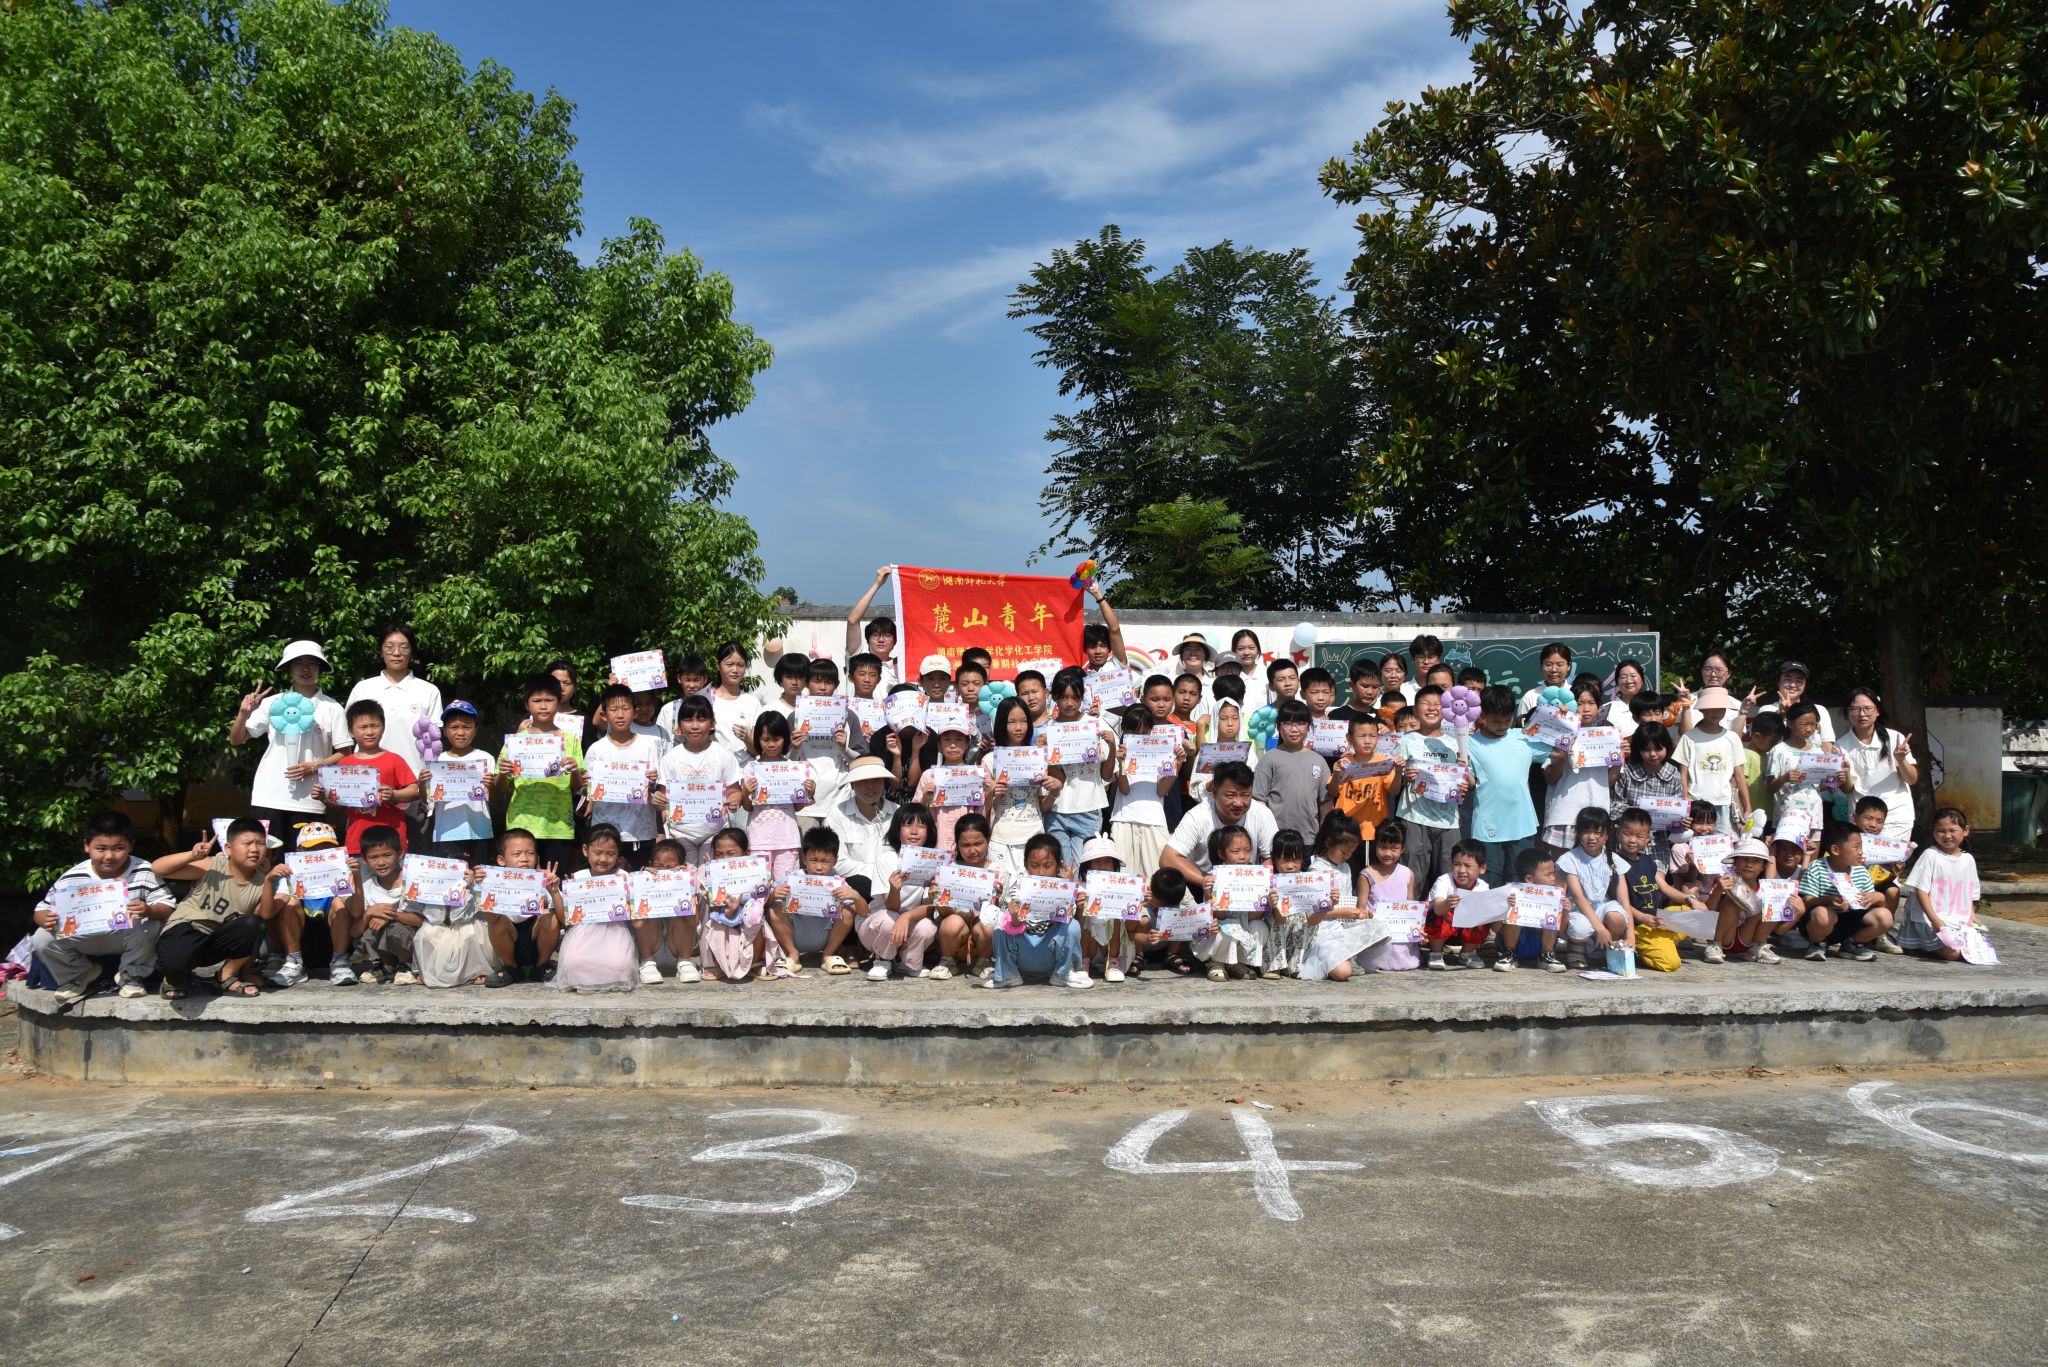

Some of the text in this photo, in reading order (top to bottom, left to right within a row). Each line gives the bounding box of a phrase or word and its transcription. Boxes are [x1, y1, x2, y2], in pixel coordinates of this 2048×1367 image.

[932, 602, 1055, 633] 麓山青年
[937, 645, 1053, 658] 湖南师学化学化工学院
[1100, 674, 1117, 682] 奖状
[816, 699, 832, 707] 奖状
[935, 704, 952, 713] 奖状
[525, 736, 543, 745] 奖状
[448, 763, 467, 771] 奖状
[611, 762, 629, 770] 奖状
[1433, 765, 1448, 773] 奖状
[340, 767, 360, 775] 奖状
[1874, 838, 1890, 847] 奖状
[304, 854, 325, 864] 奖状
[921, 850, 937, 859] 奖状
[428, 860, 447, 869] 奖状
[728, 861, 747, 870] 奖状
[504, 870, 523, 880] 奖状
[959, 868, 976, 878] 奖状
[1236, 868, 1254, 876] 奖状
[652, 873, 672, 882] 奖状
[804, 878, 824, 886] 奖状
[1110, 875, 1127, 884] 奖状
[1296, 875, 1313, 884] 奖状
[586, 879, 606, 889] 奖状
[1040, 880, 1058, 889] 奖状
[79, 885, 102, 896] 奖状
[1527, 886, 1544, 895] 奖状
[1392, 903, 1409, 911] 奖状
[1180, 909, 1197, 917] 奖状
[243, 1123, 519, 1223] 2
[621, 1108, 858, 1213] 3
[1102, 1108, 1366, 1222] 4
[1526, 1094, 1781, 1188] 5
